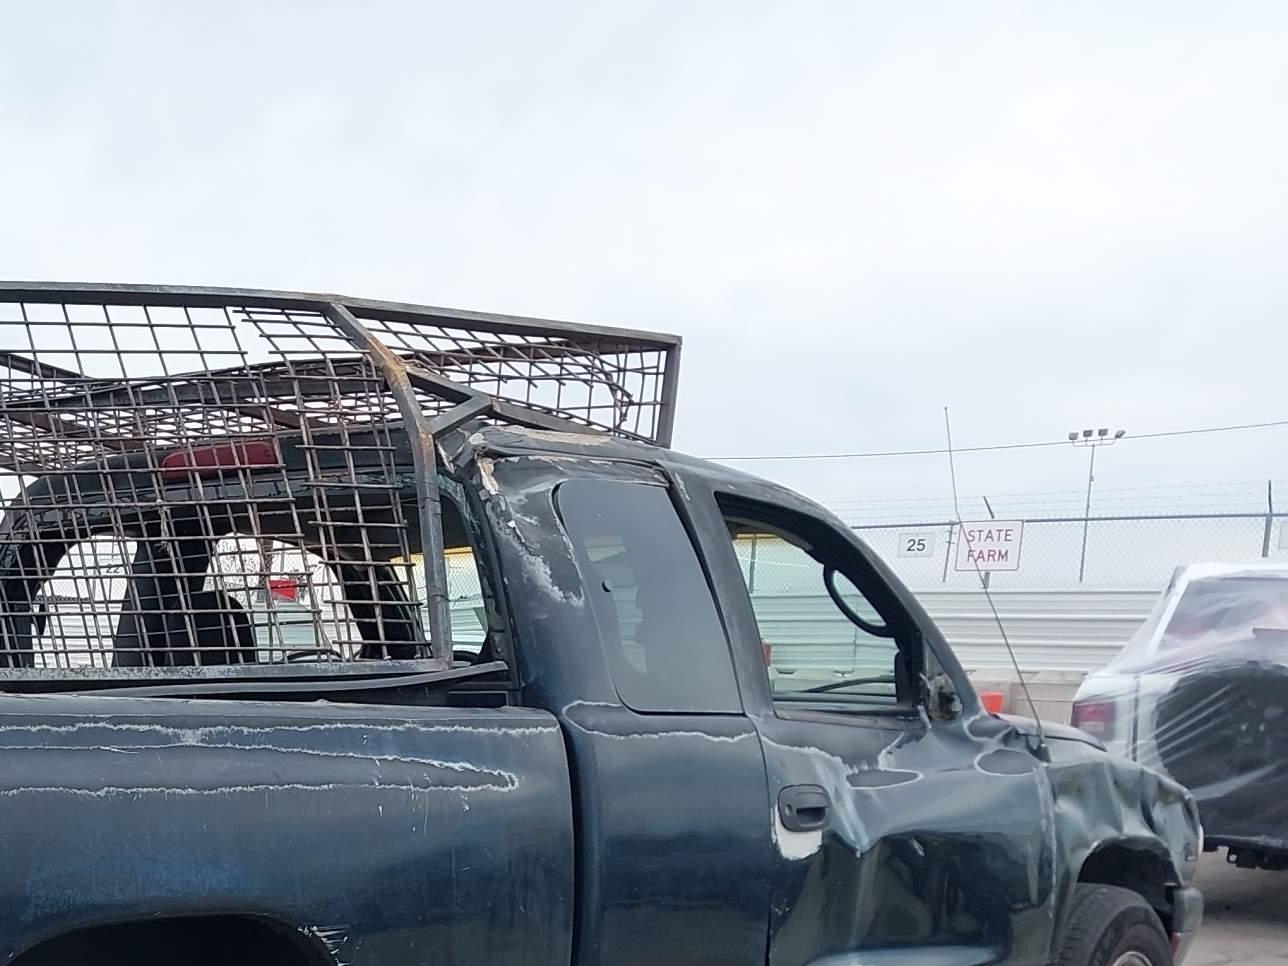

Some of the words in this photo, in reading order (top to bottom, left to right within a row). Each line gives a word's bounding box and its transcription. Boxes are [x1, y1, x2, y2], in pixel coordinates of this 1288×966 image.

[967, 528, 1014, 543] STATE
[906, 538, 926, 552] 25
[966, 549, 1009, 562] FARM
[105, 563, 121, 573] 22
